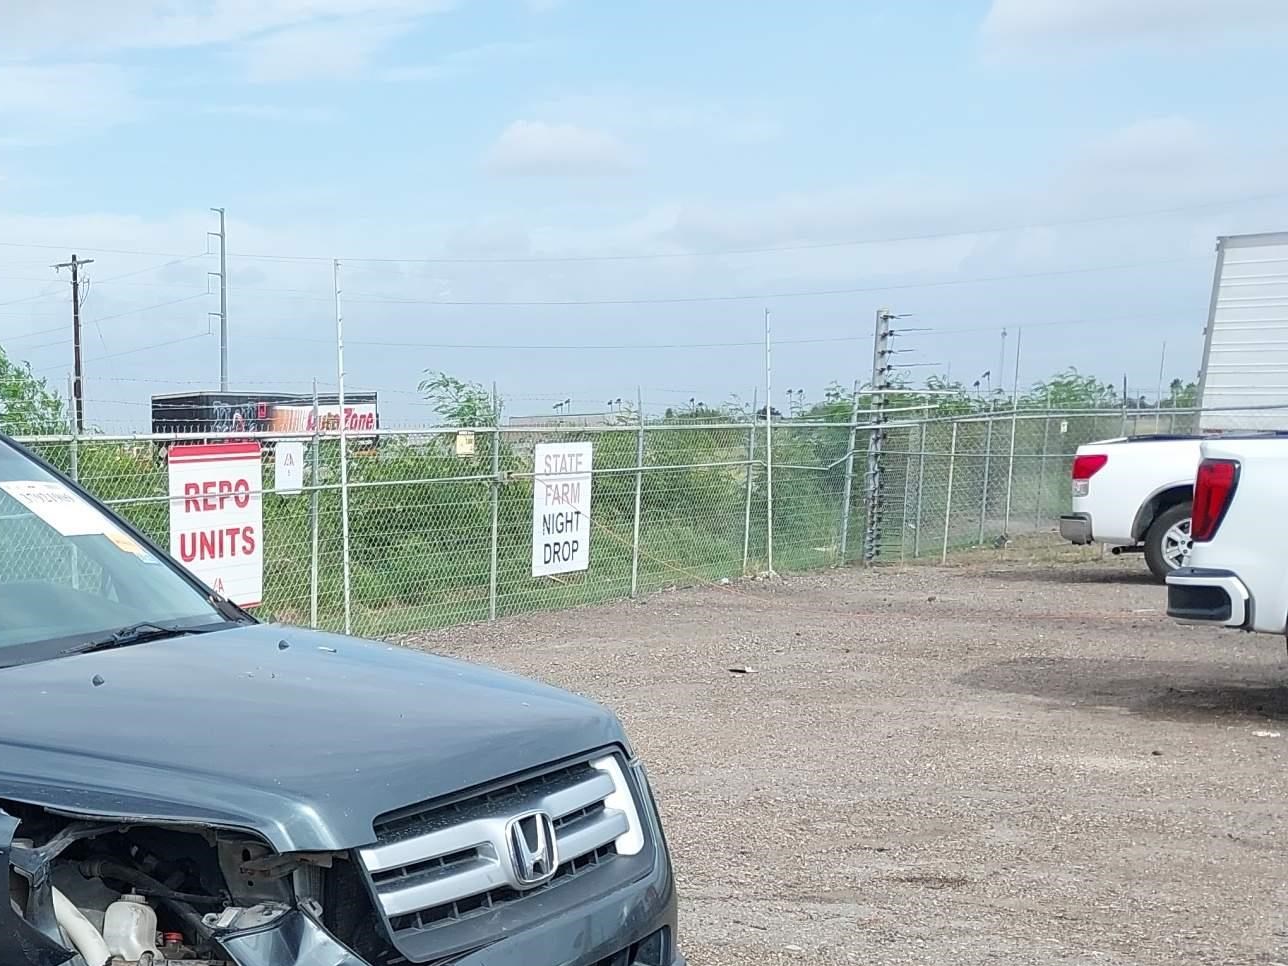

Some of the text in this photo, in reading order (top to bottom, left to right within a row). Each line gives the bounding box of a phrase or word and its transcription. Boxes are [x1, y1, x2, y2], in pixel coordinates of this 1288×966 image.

[543, 453, 583, 475] STATE
[184, 478, 250, 513] REPO
[544, 482, 581, 506] FARM
[542, 510, 581, 536] NIGHT
[179, 526, 256, 563] UNITS
[543, 539, 579, 564] DROP
